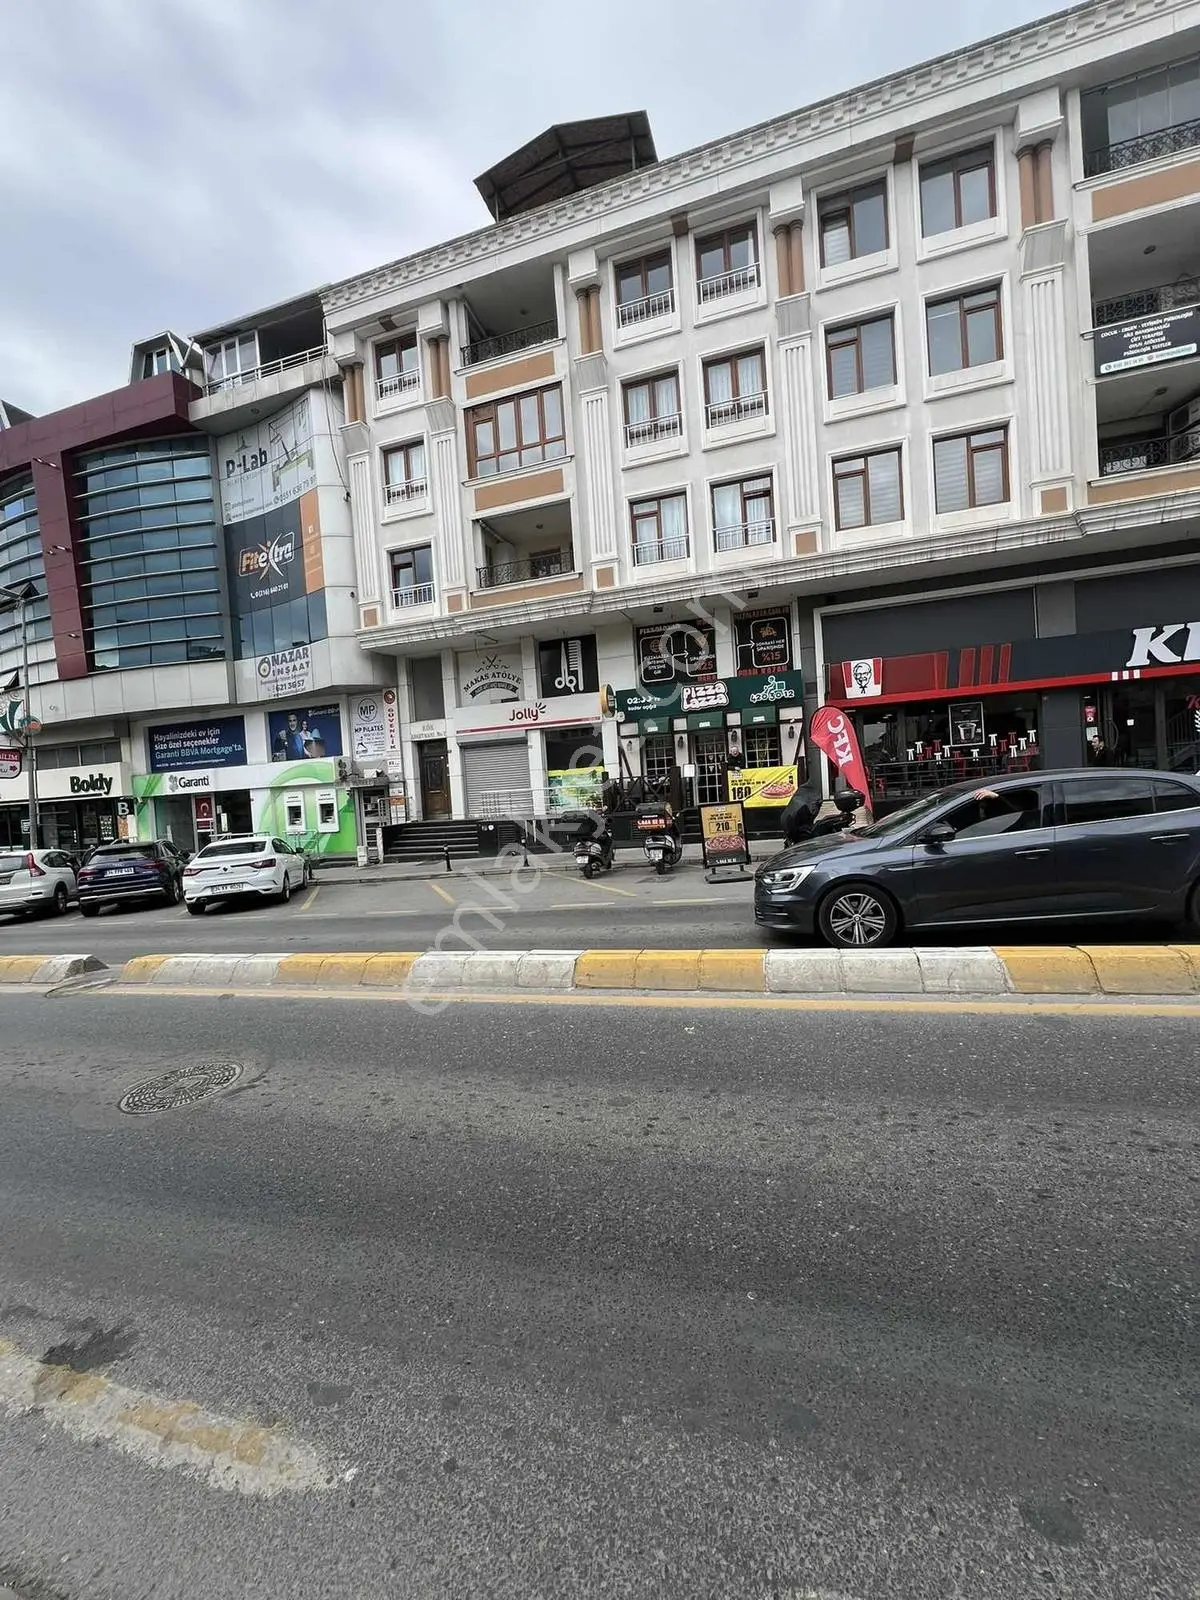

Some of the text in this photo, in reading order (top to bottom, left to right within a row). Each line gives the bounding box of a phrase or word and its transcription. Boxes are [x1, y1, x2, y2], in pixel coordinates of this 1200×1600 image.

[271, 647, 309, 666] NAZAR
[463, 673, 489, 692] MAKAS
[360, 704, 375, 716] MP
[509, 707, 539, 721] Jolly
[154, 730, 197, 742] Hayalinizdeki
[827, 715, 854, 768] KFC
[168, 741, 182, 749] özel
[183, 737, 219, 748] seçenekler
[155, 751, 180, 759] Garanti
[180, 748, 200, 757] BBVA
[70, 773, 113, 794] Boldy
[178, 775, 209, 788] Garanti
[117, 802, 130, 815] B
[716, 821, 730, 831] 210
